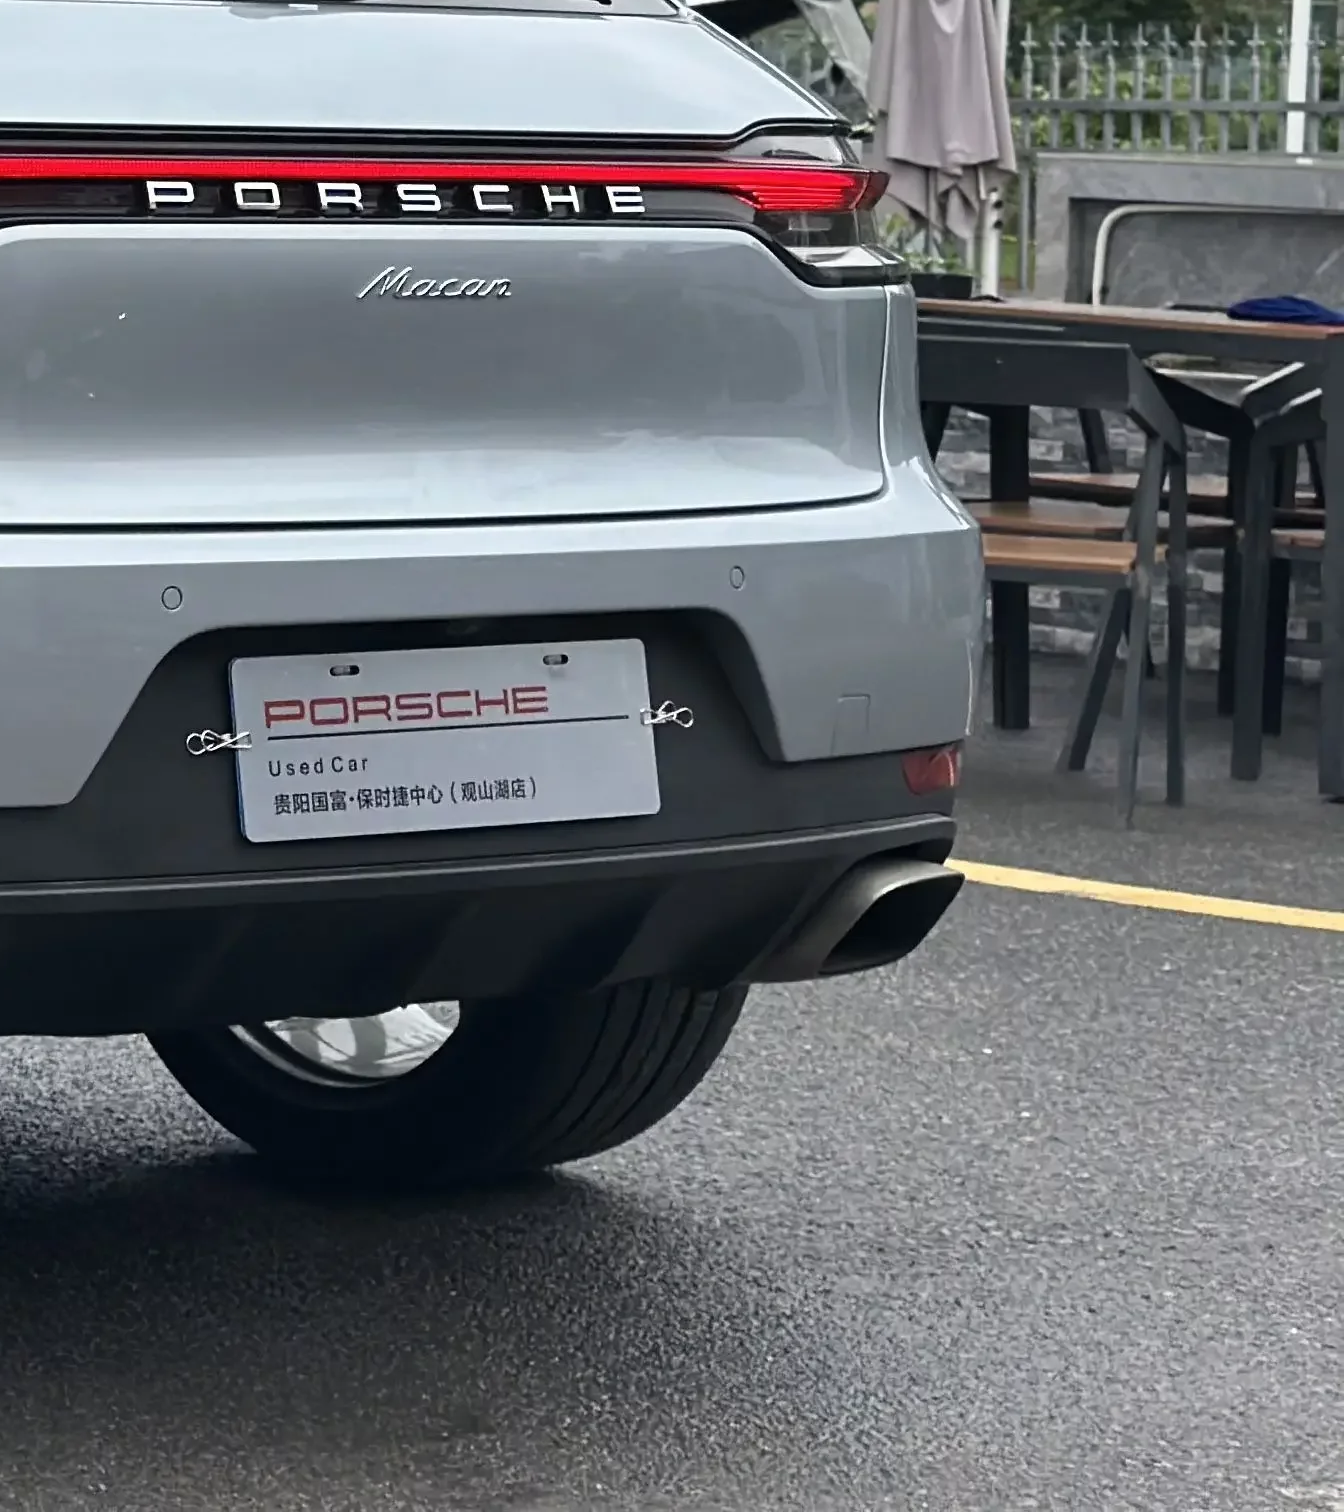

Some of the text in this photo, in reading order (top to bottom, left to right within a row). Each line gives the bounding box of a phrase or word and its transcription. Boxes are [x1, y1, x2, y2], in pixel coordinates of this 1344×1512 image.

[144, 179, 646, 213] PORSCHE
[356, 265, 512, 301] Macan
[263, 685, 549, 729] PORSCHE
[268, 755, 369, 778] Used Car
